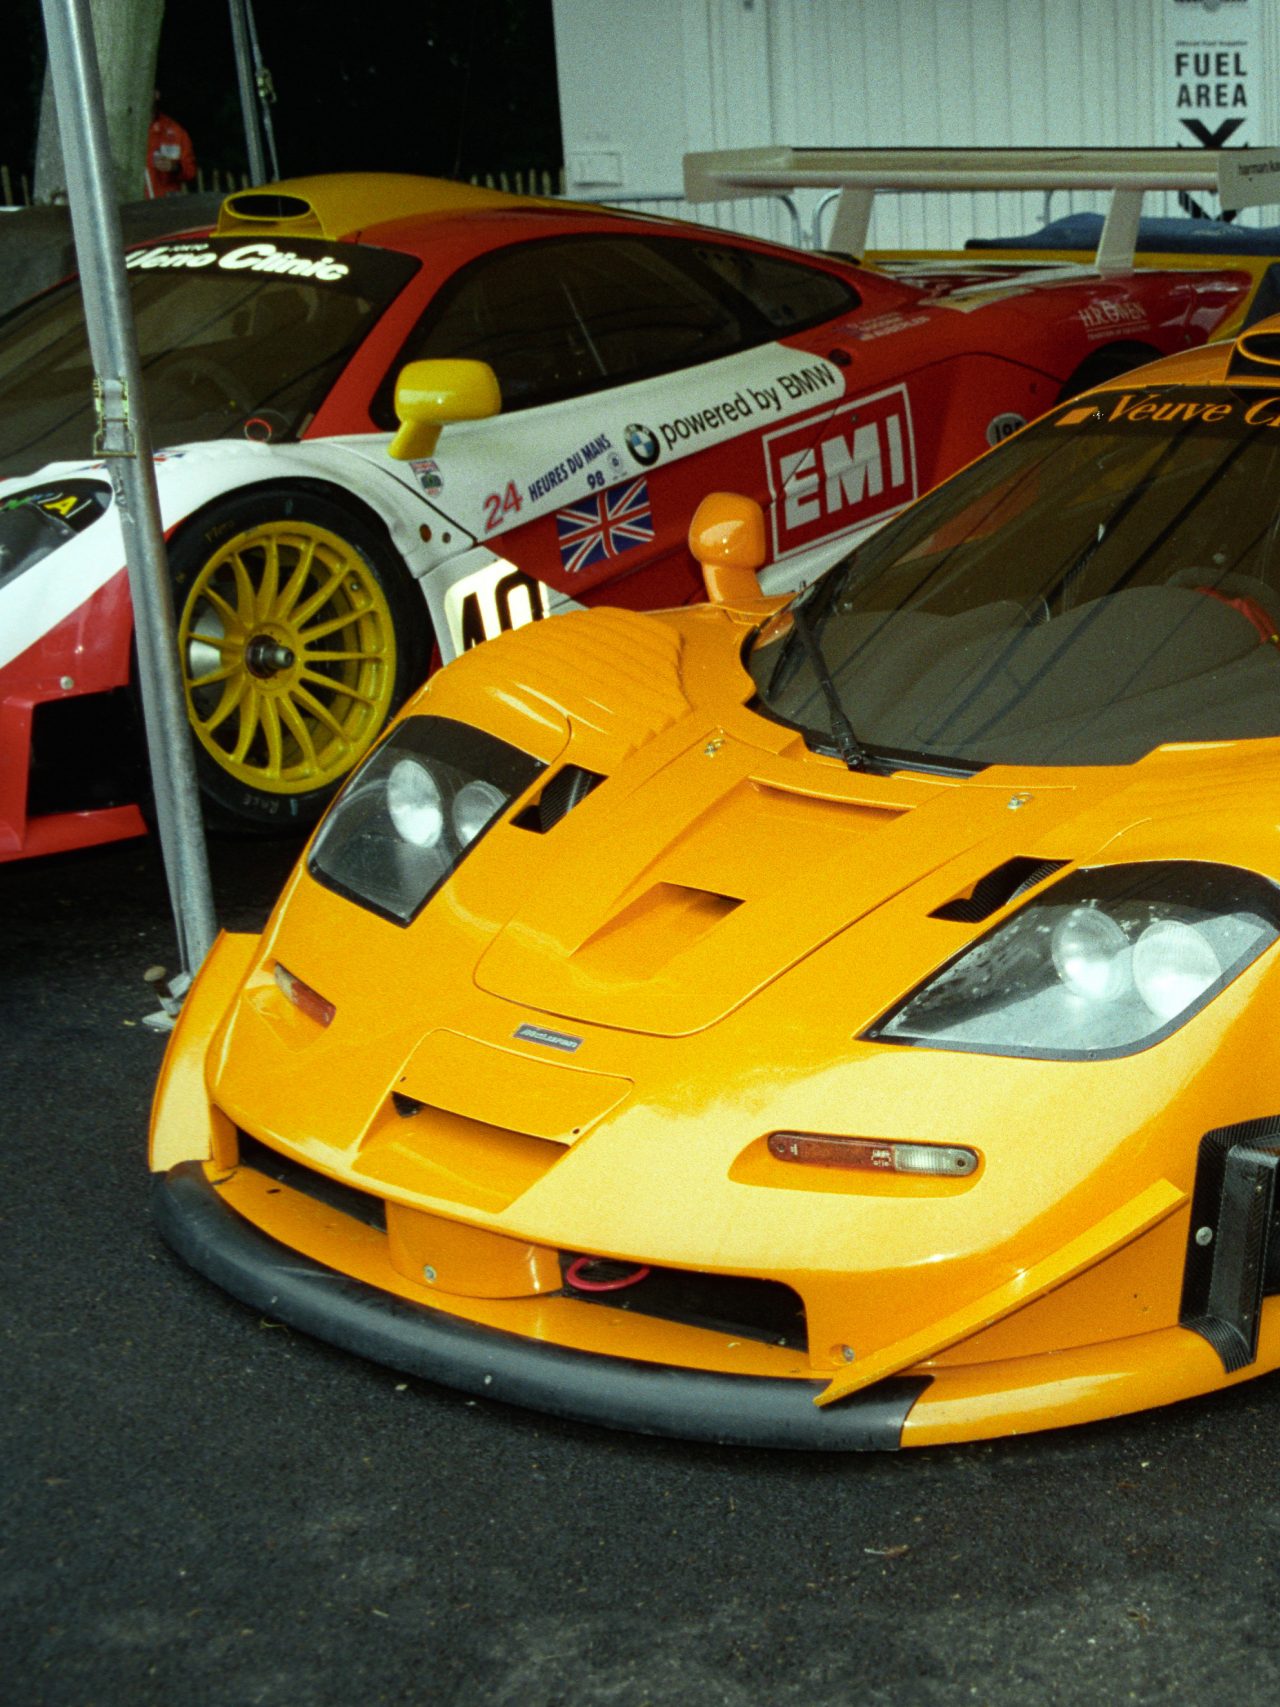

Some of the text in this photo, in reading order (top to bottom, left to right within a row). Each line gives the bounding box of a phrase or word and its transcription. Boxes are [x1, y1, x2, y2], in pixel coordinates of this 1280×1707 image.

[1175, 52, 1247, 77] FUEL
[1177, 83, 1247, 107] AREA
[218, 243, 349, 281] Clinic
[659, 363, 836, 451] powered by BMW
[1108, 393, 1233, 423] Veuve
[482, 479, 524, 534] 24
[528, 463, 569, 502] HEURES
[566, 454, 584, 476] DU
[581, 433, 612, 465] MANS
[586, 470, 606, 490] 98
[779, 413, 906, 531] EMI
